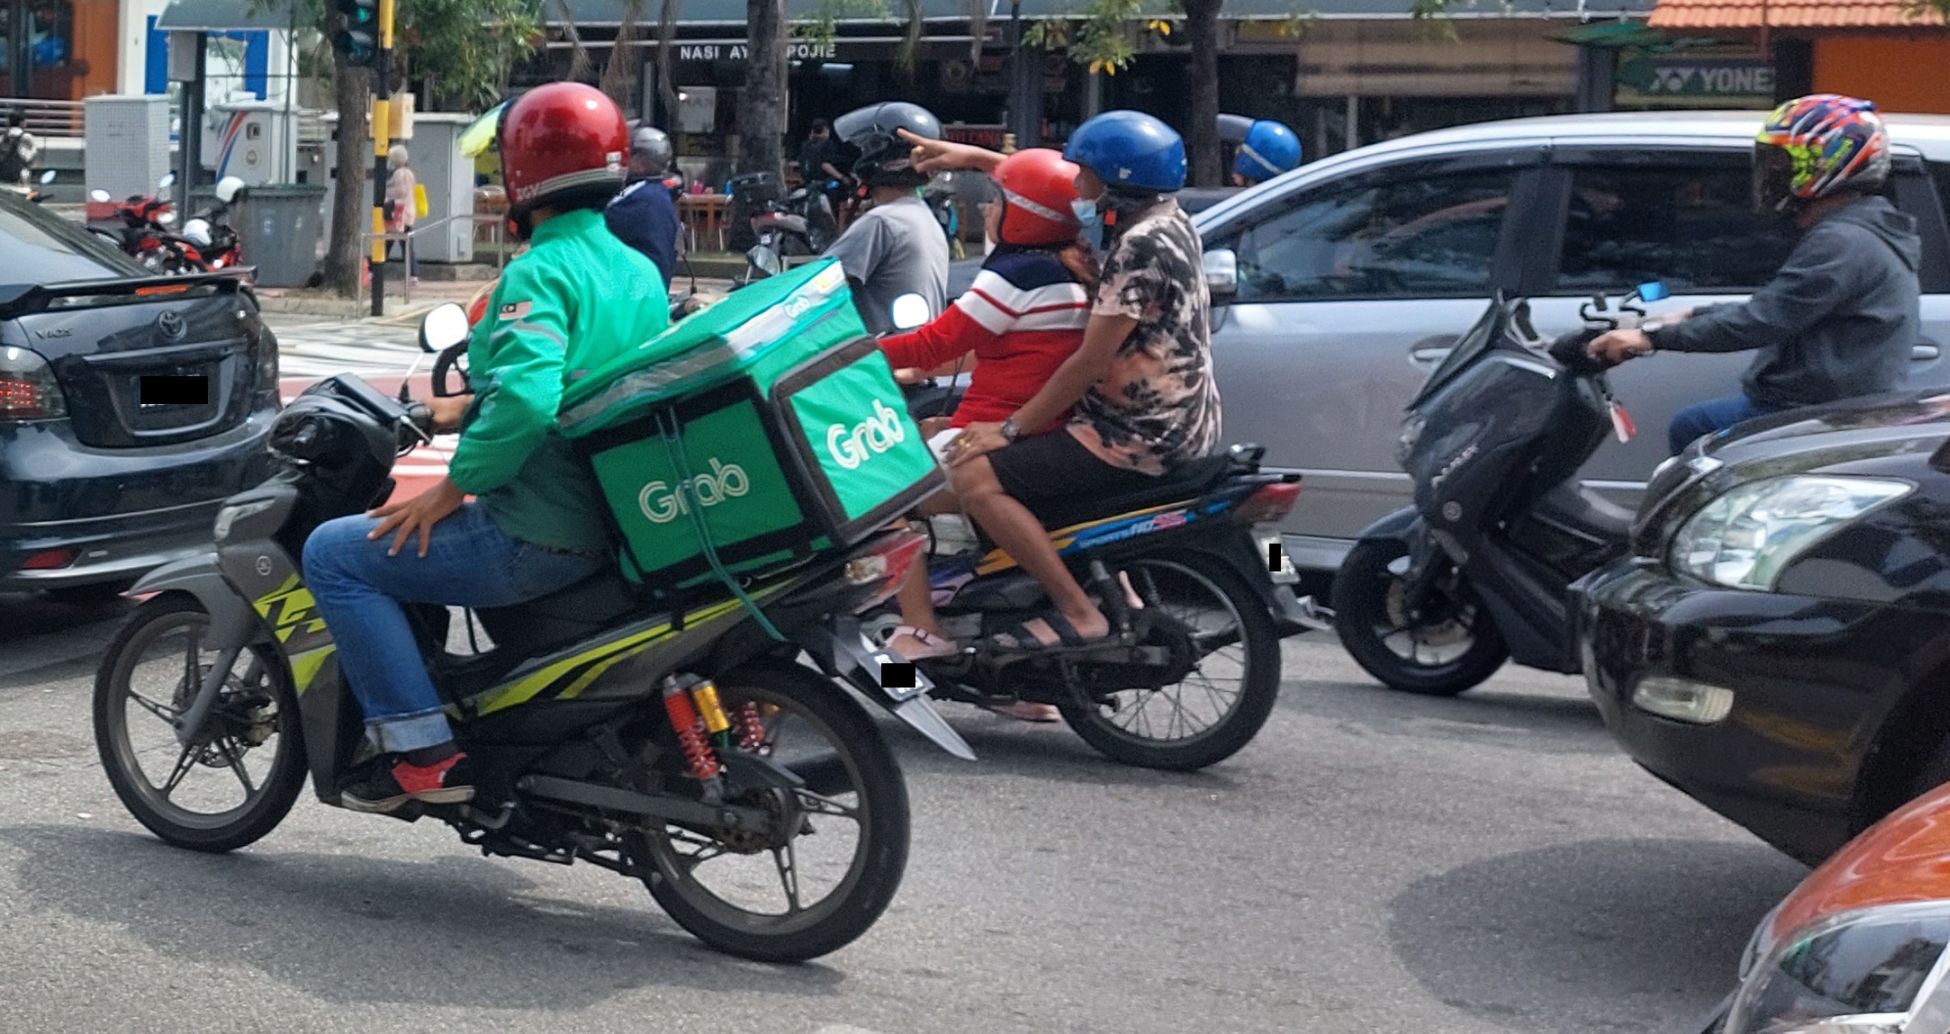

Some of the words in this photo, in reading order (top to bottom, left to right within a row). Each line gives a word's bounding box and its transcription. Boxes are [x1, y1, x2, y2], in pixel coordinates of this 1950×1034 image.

[680, 46, 719, 60] NASI
[729, 46, 749, 60] AY
[786, 44, 837, 59] POJIE
[1701, 66, 1776, 92] YONE
[826, 398, 906, 470] Grab
[638, 457, 750, 524] Grab
